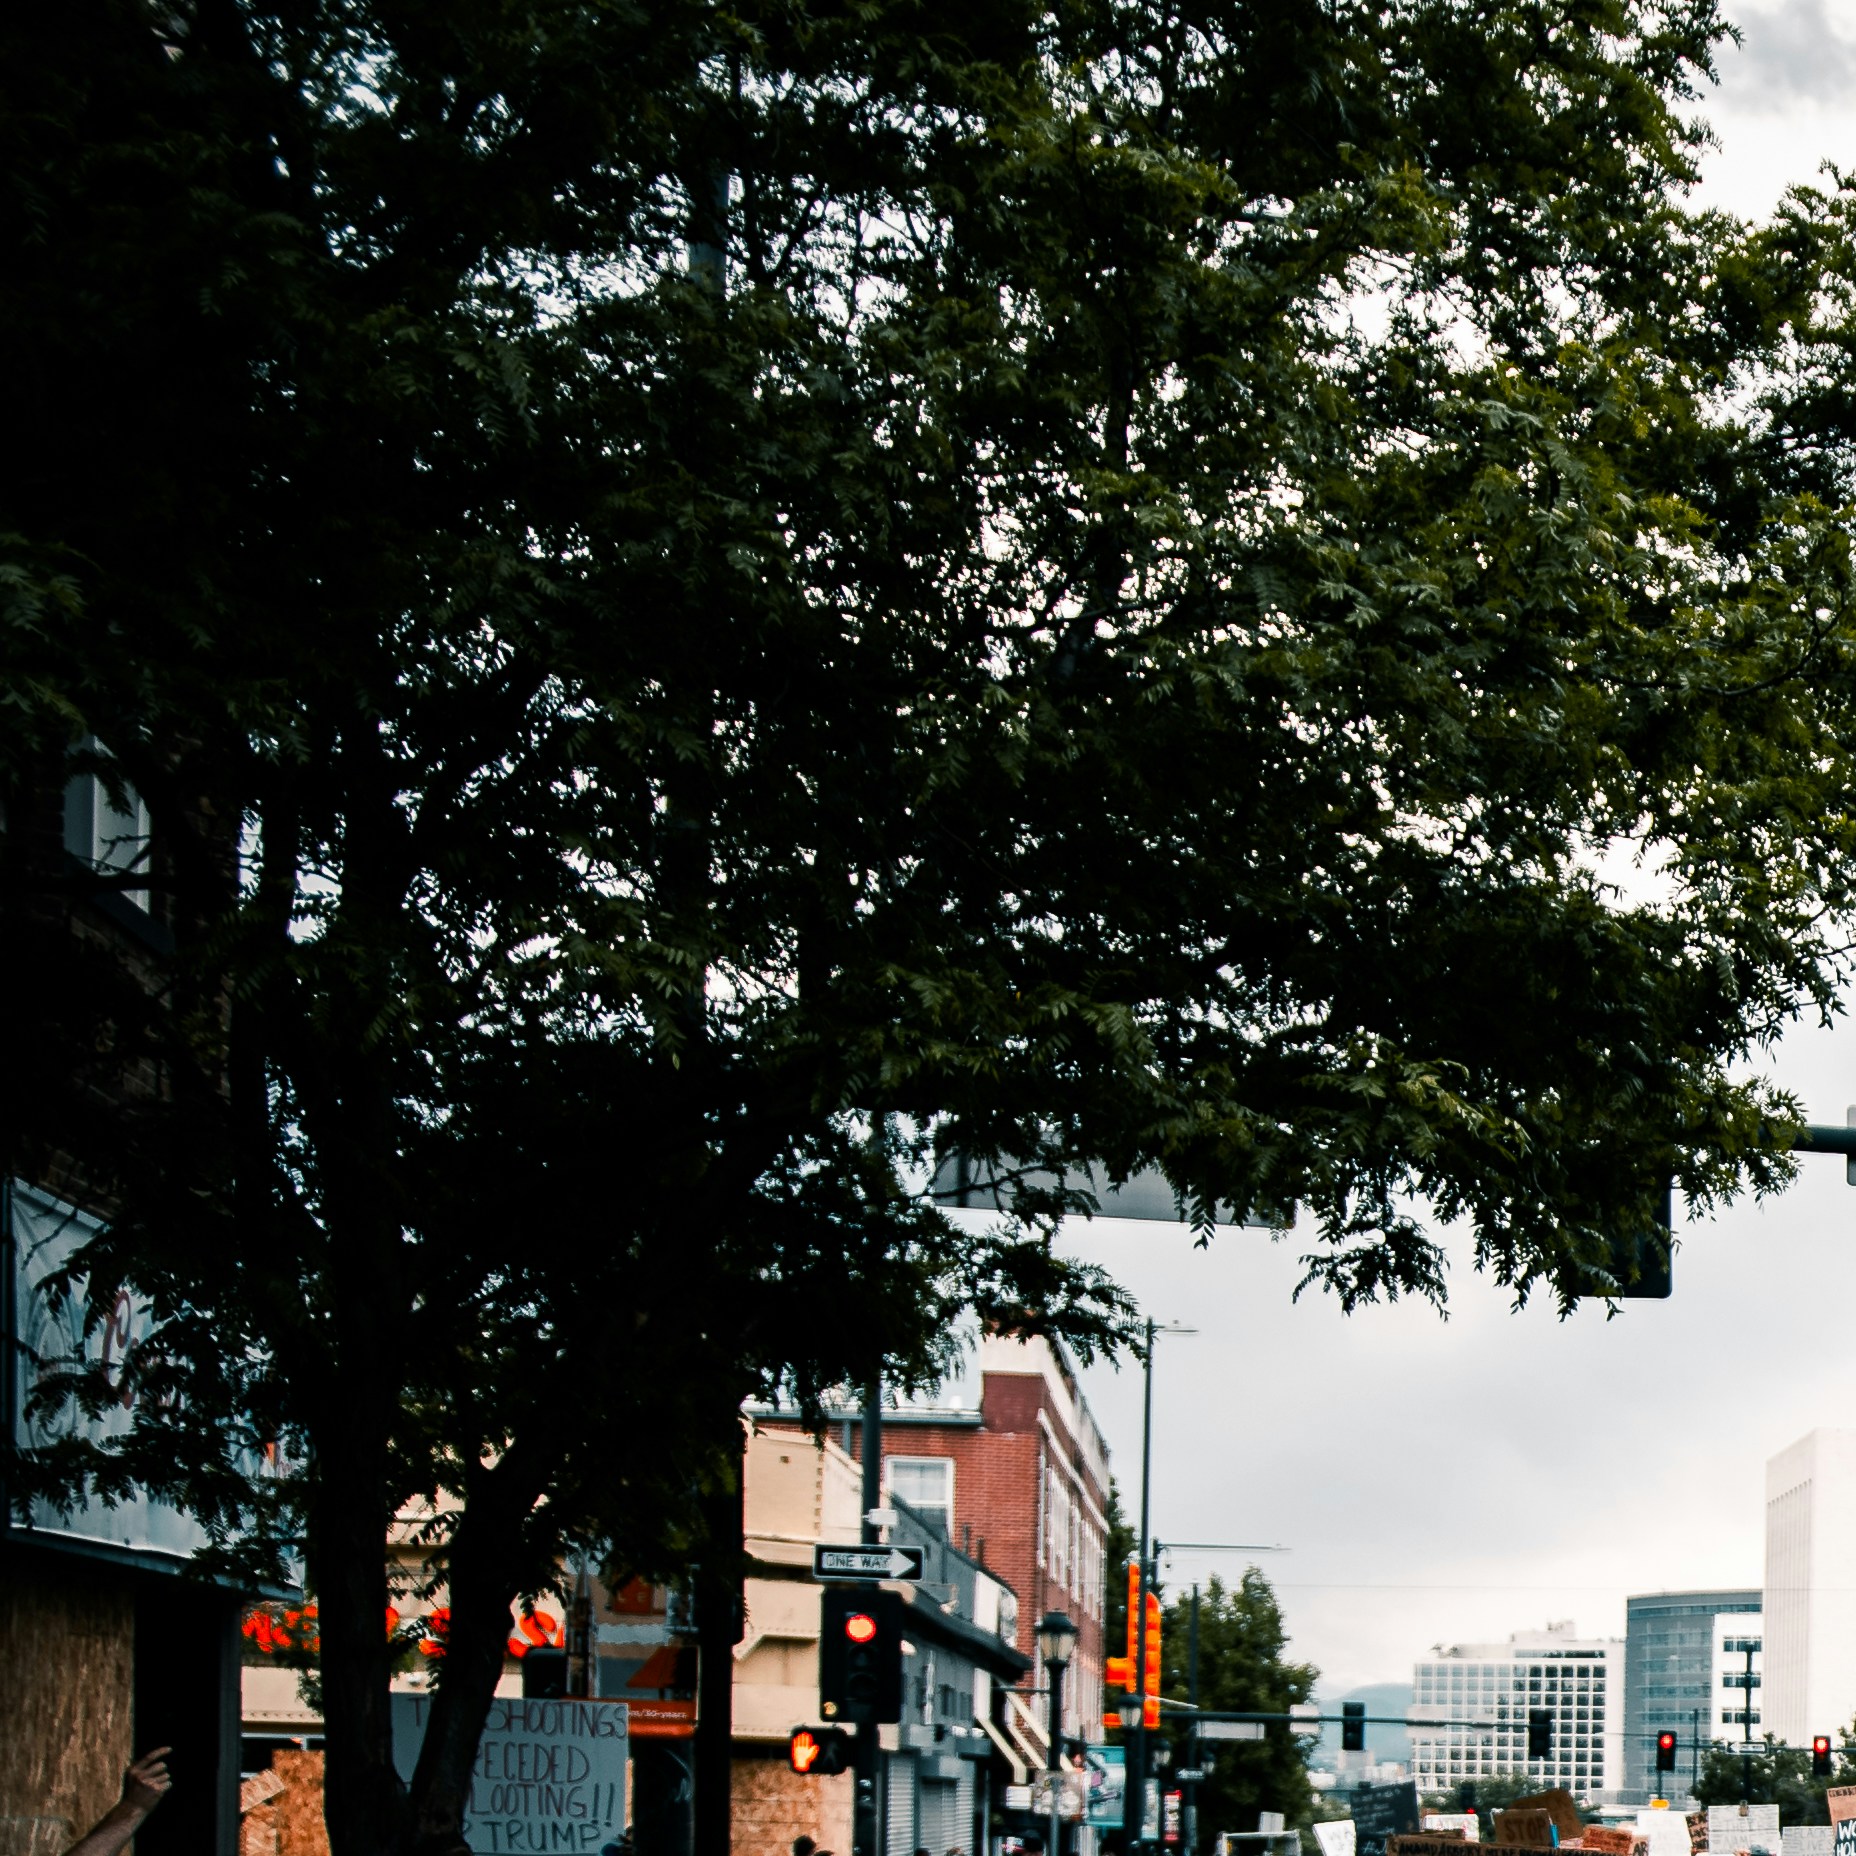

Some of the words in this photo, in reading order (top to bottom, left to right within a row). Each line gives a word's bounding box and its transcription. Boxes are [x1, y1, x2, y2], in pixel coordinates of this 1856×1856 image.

[825, 1554, 853, 1568] ONE
[481, 1819, 601, 1852] TRUMP
[1503, 1819, 1548, 1842] STOP
